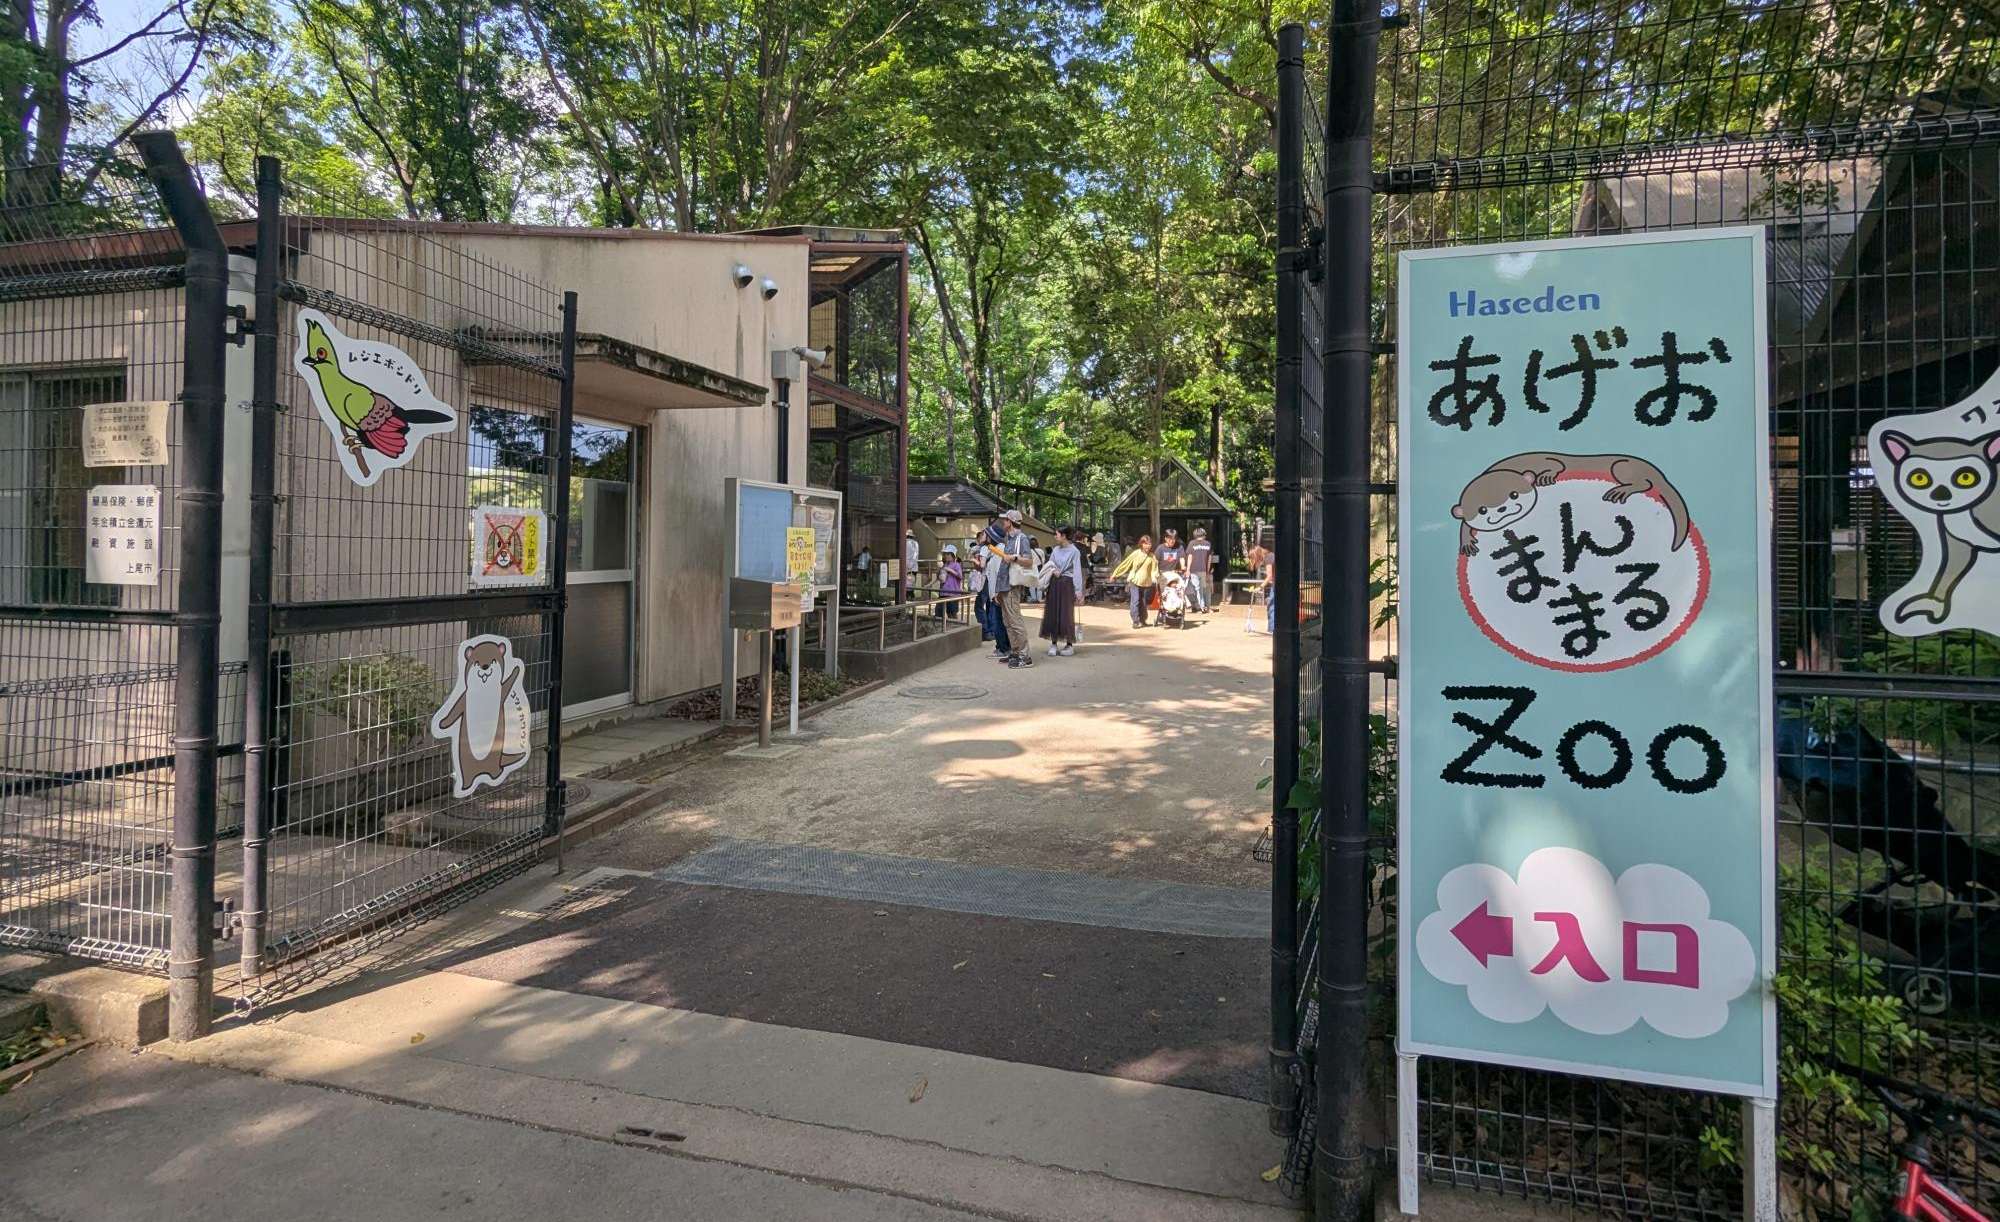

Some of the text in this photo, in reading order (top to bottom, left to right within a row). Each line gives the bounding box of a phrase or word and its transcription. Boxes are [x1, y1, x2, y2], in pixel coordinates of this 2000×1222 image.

[1448, 286, 1600, 318] Haseden
[348, 350, 421, 394] ムジエボシドリ
[1427, 326, 1732, 431] あげお
[126, 562, 153, 573] 上尾市
[528, 520, 537, 570] ペット禁止
[1530, 911, 1700, 990] 入口
